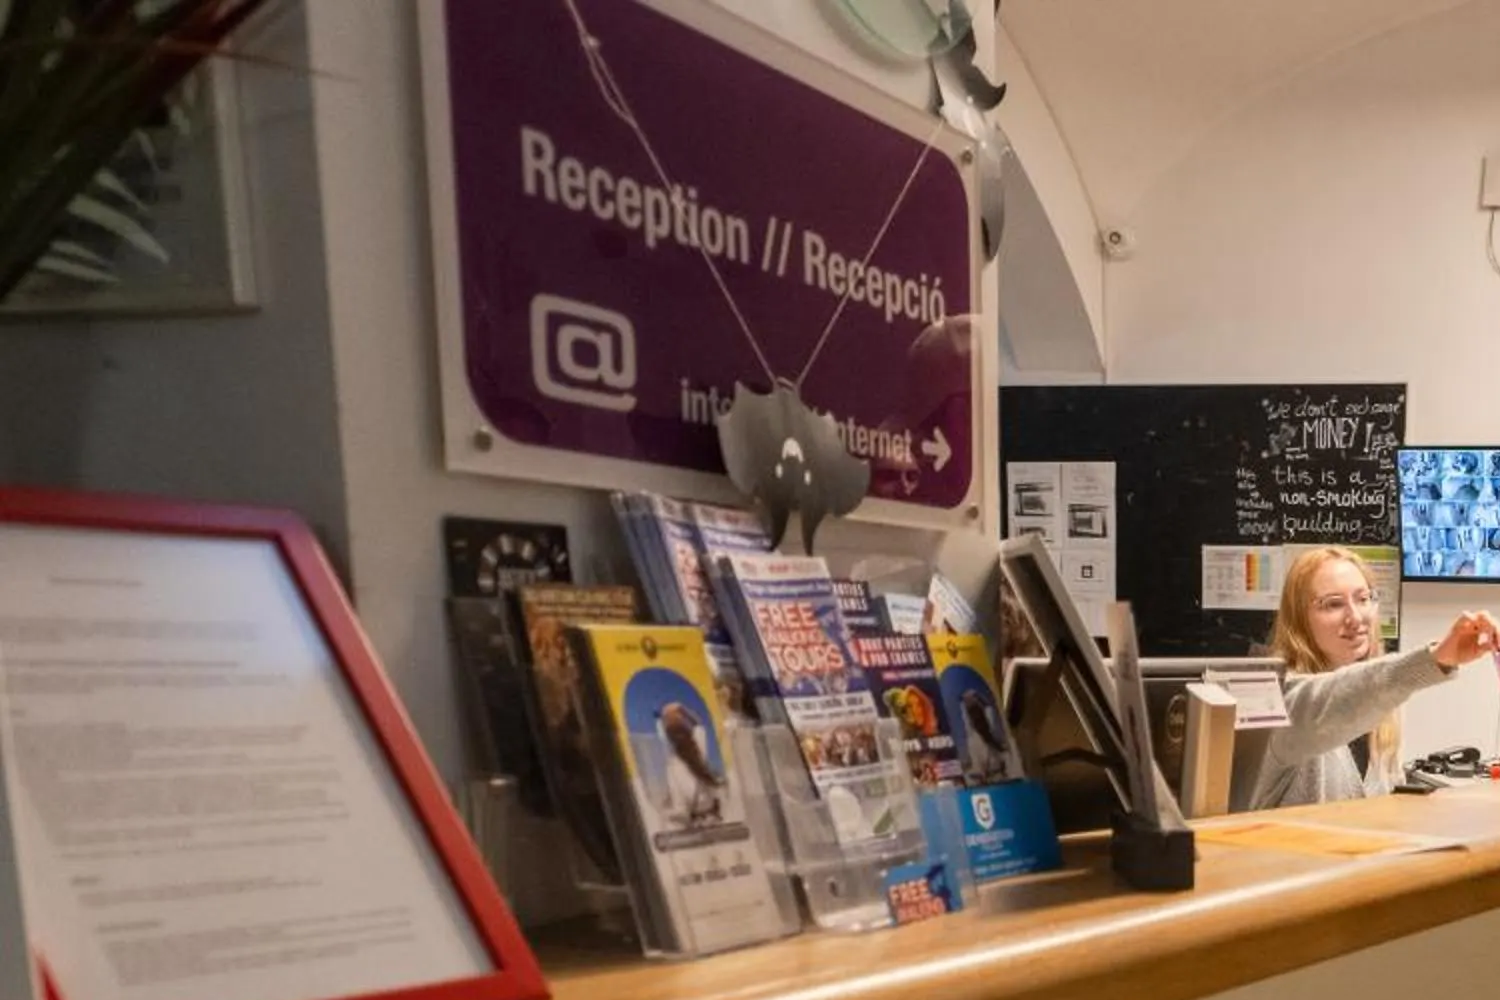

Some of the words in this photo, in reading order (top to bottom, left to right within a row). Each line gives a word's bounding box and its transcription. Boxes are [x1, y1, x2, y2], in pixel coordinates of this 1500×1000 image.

[520, 126, 749, 266] Reception
[803, 230, 946, 327] Recepció
[1302, 417, 1359, 450] MONEY
[1273, 465, 1313, 485] this
[1321, 468, 1337, 485] is
[1350, 471, 1366, 485] a
[1283, 512, 1362, 542] building
[757, 602, 821, 630] FREE
[770, 644, 846, 675] TOURS
